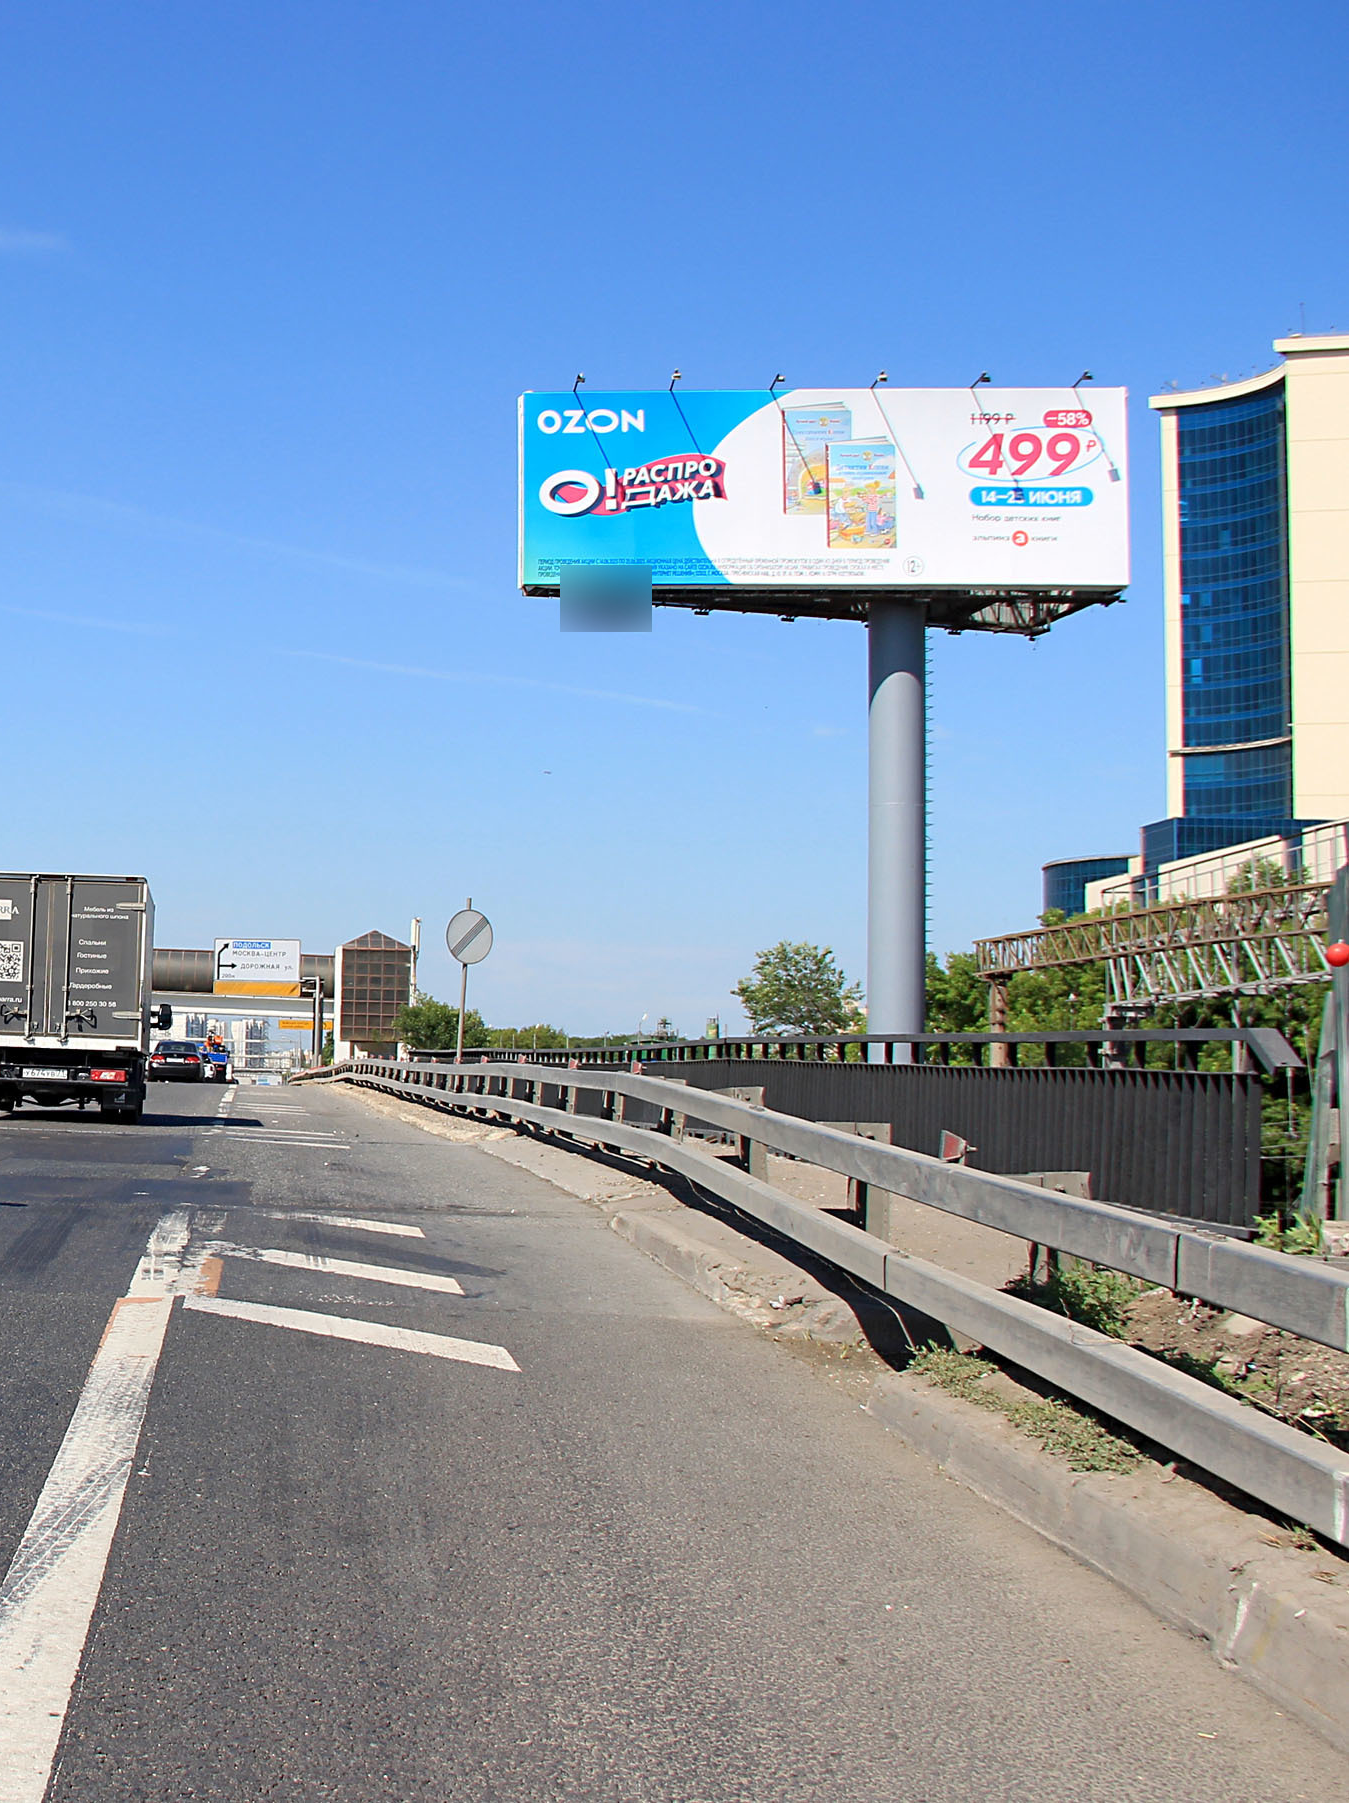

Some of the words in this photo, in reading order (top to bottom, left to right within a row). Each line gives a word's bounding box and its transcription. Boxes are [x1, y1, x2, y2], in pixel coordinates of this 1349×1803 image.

[537, 409, 645, 434] OZON
[968, 432, 1081, 476] 499
[623, 459, 717, 486] РАСПРО
[621, 479, 715, 510] ДАЖА
[1029, 490, 1082, 504] ИЮНЯ
[907, 560, 921, 573] 12+
[76, 967, 109, 975] Прихожие
[69, 982, 112, 990] Гардеробные
